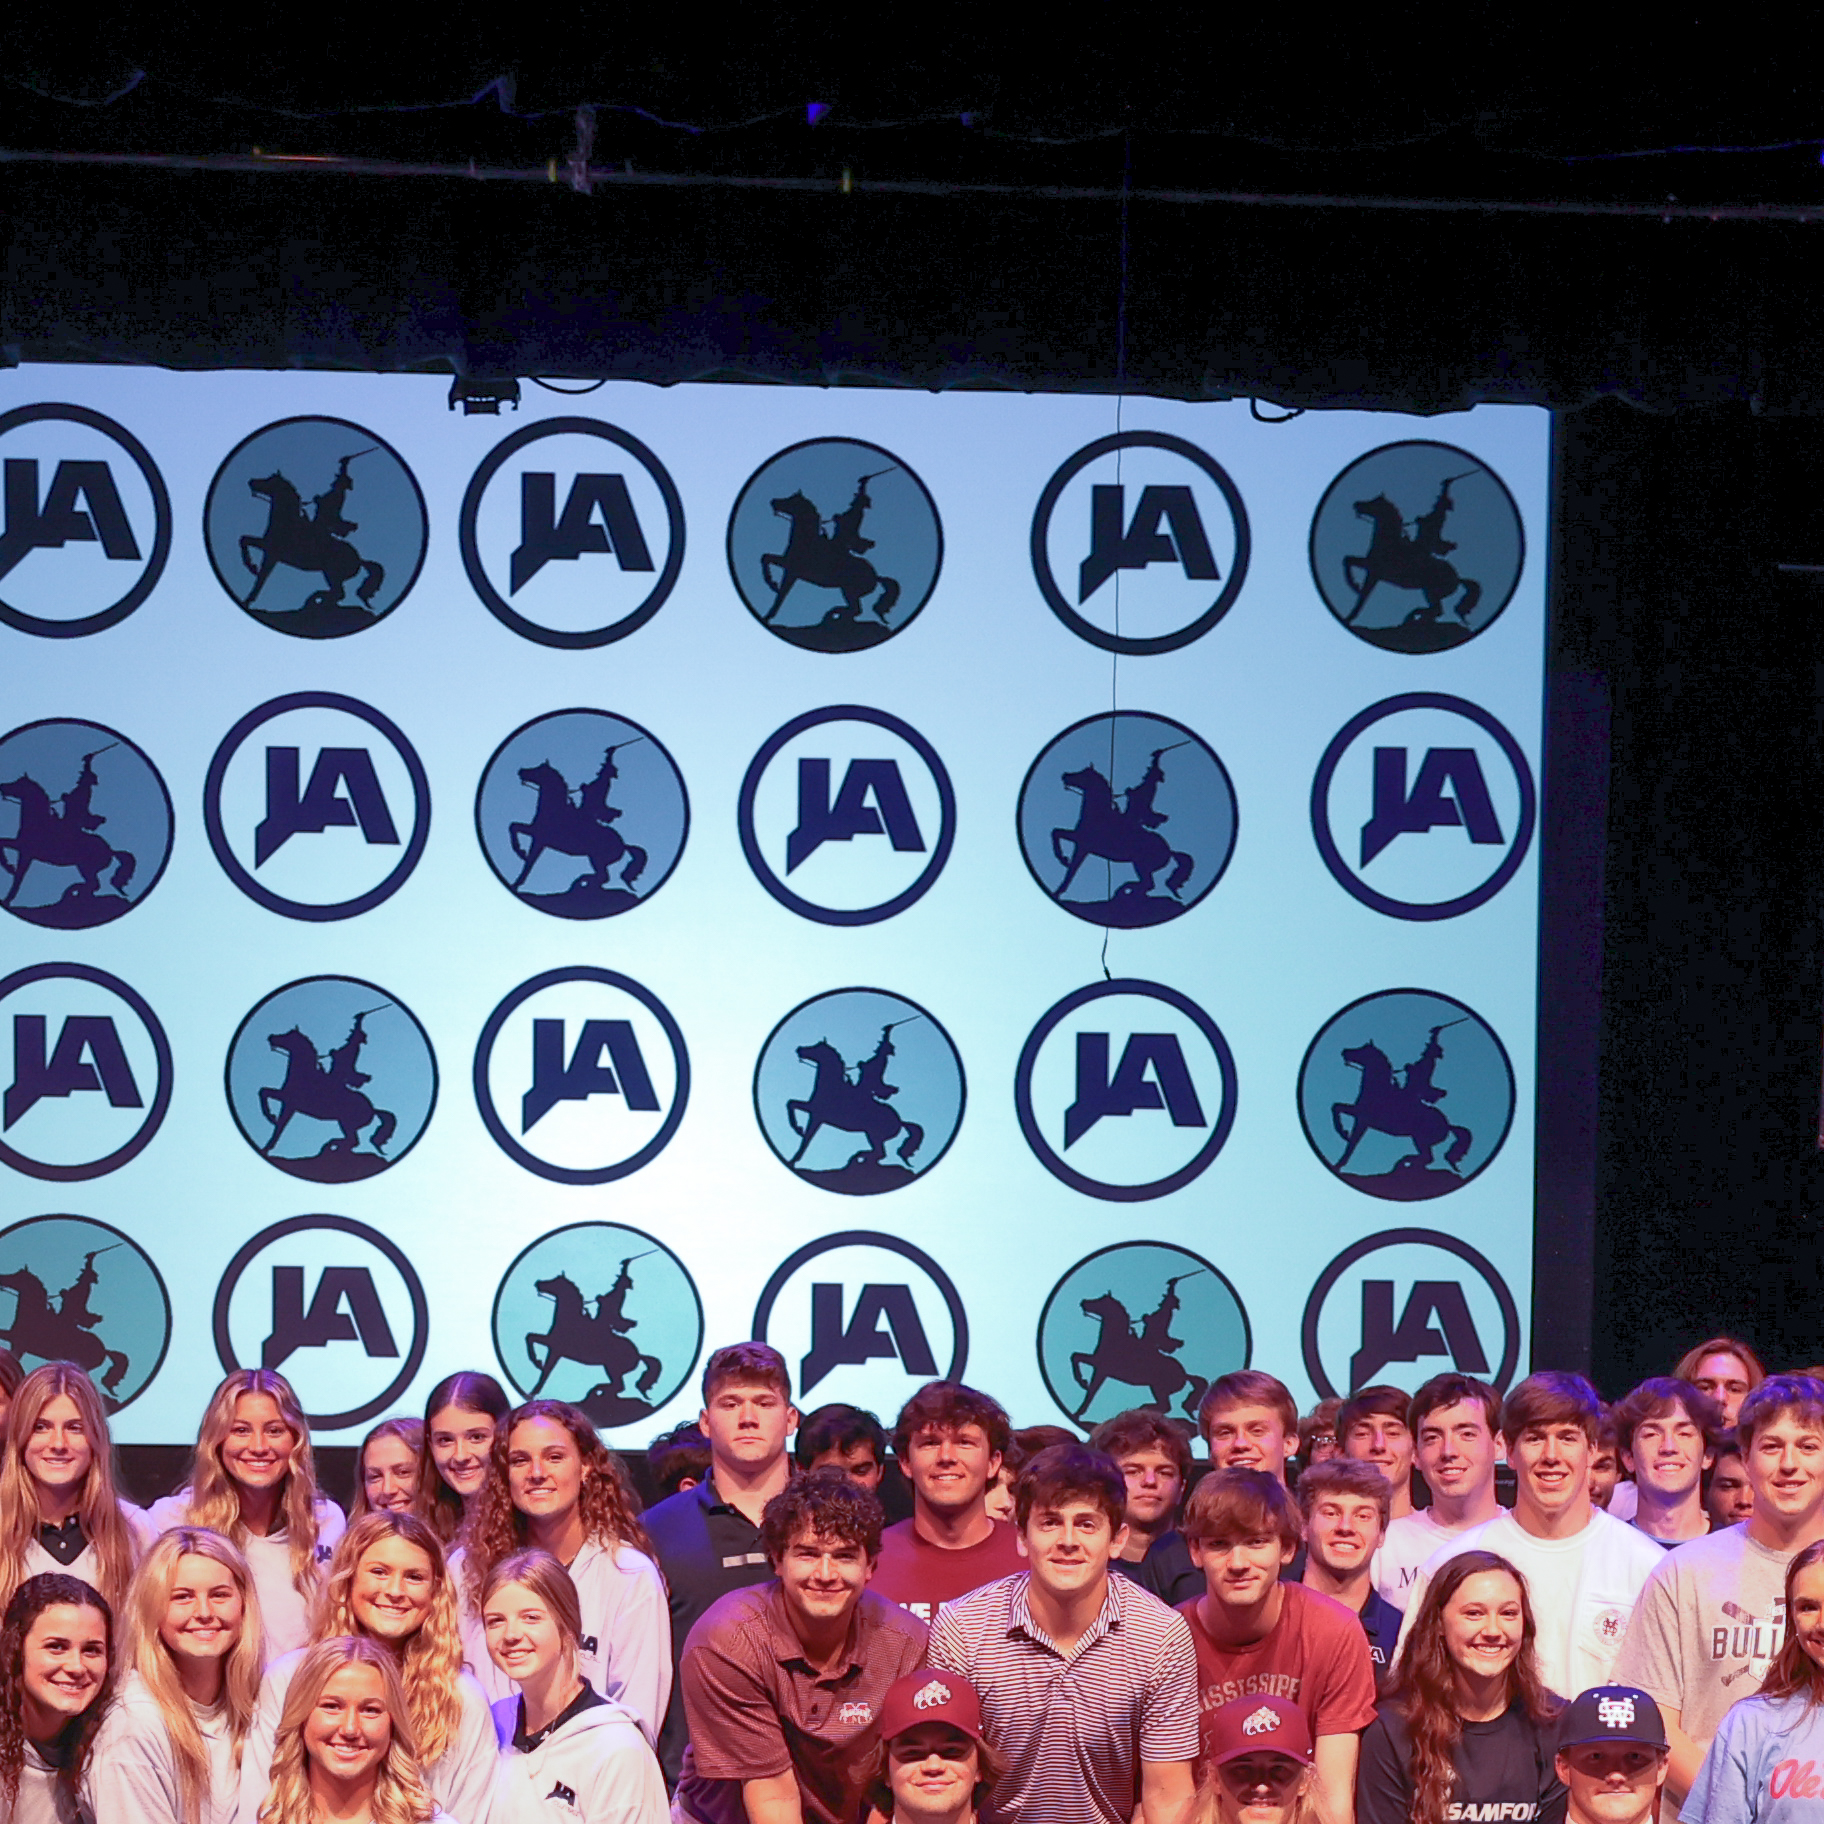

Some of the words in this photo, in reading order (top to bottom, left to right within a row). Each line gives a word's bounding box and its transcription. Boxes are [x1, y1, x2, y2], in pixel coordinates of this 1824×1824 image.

[510, 472, 655, 597] JA
[1078, 484, 1221, 606] JA
[255, 746, 400, 869] JA
[786, 757, 927, 877] JA
[1360, 746, 1505, 870] JA
[4, 1014, 144, 1133] JA
[522, 1018, 661, 1135] JA
[1064, 1032, 1207, 1152] JA
[261, 1266, 400, 1373] JA
[800, 1282, 940, 1399] JA
[1349, 1280, 1492, 1398] JA
[1769, 1758, 1821, 1799] Ole
